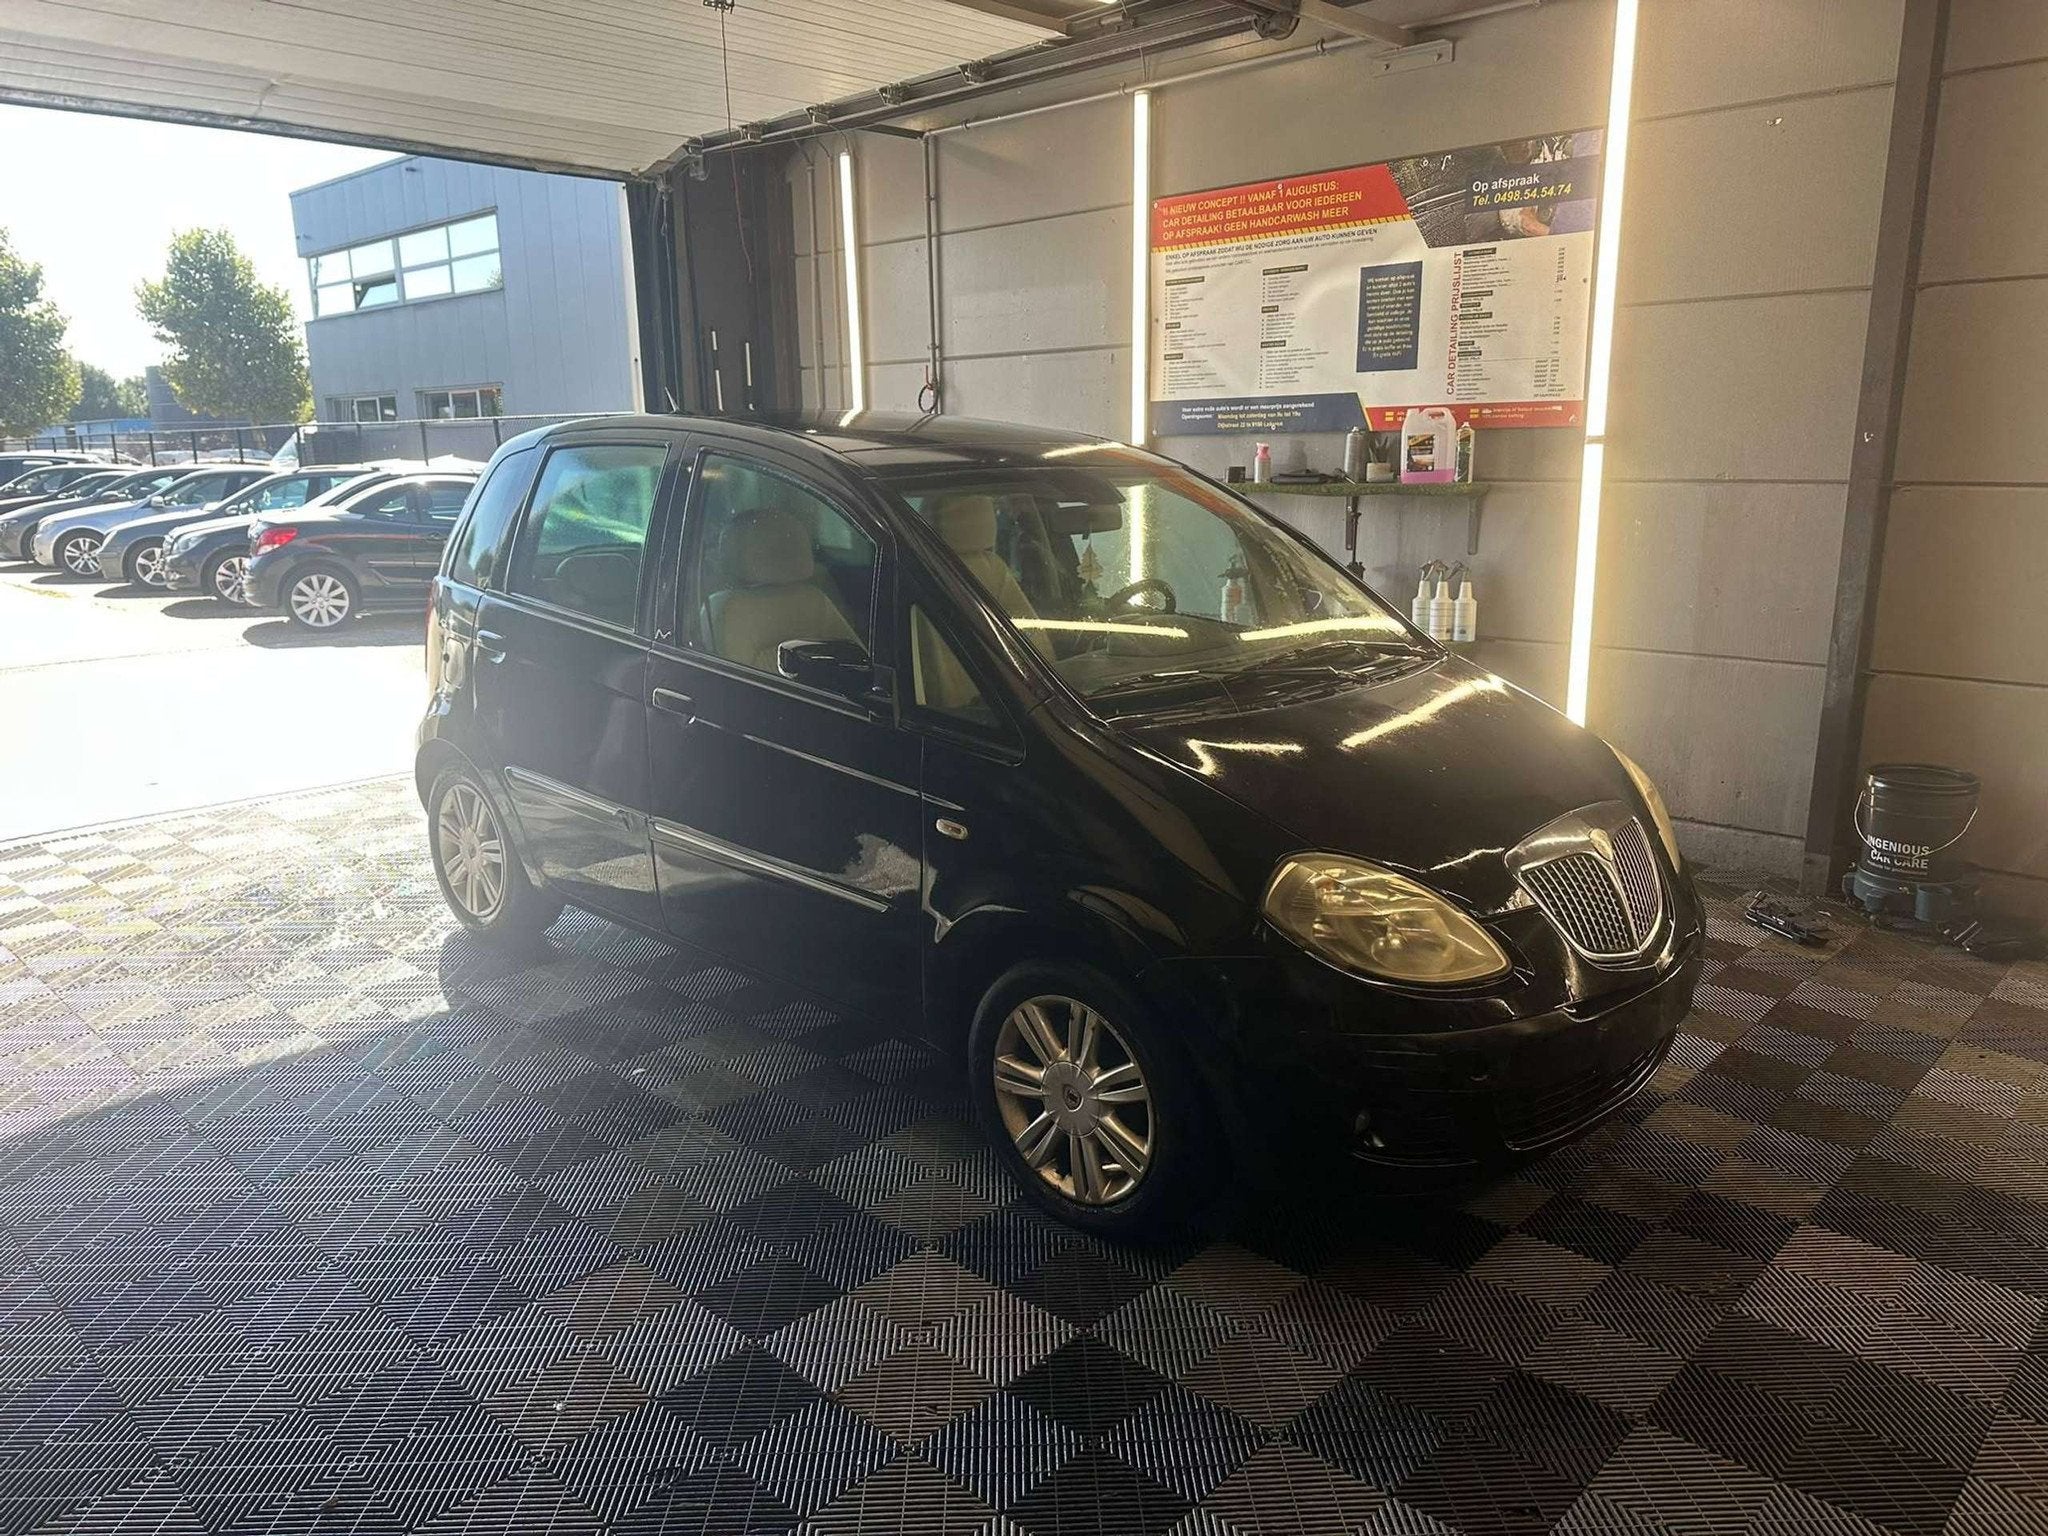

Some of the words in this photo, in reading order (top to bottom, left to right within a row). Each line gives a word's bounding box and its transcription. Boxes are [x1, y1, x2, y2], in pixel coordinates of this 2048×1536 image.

[1170, 204, 1196, 214] NIEUW
[1198, 196, 1238, 210] CONCEPT
[1240, 195, 1246, 204] !!
[1248, 190, 1277, 202] VANAF
[1278, 189, 1283, 198] 1
[1286, 180, 1340, 197] AUGUSTUS:
[1472, 181, 1488, 192] Op
[1491, 173, 1540, 190] afspraak
[1472, 194, 1490, 206] Tel.
[1494, 183, 1572, 204] 0498.54.54.74
[1163, 218, 1180, 228] CAR
[1182, 212, 1224, 226] DETAILING
[1226, 202, 1284, 219] BETAALBAAR
[1286, 198, 1312, 210] VOOR
[1314, 191, 1362, 206] IEDEREEN
[1163, 230, 1174, 240] OP
[1176, 224, 1222, 239] AFSPRAAK!
[1224, 220, 1248, 231] GEEN
[1250, 210, 1320, 228] HANDCARWASH
[1322, 206, 1349, 218] MEER
[1332, 230, 1356, 239] KUNNEN
[1357, 228, 1378, 236] GEVEN
[1452, 252, 1462, 312] PRIJSLIJST
[1448, 314, 1458, 370] DETAILING
[1446, 371, 1455, 396] CAR
[1867, 834, 1930, 855] INGENIOUS
